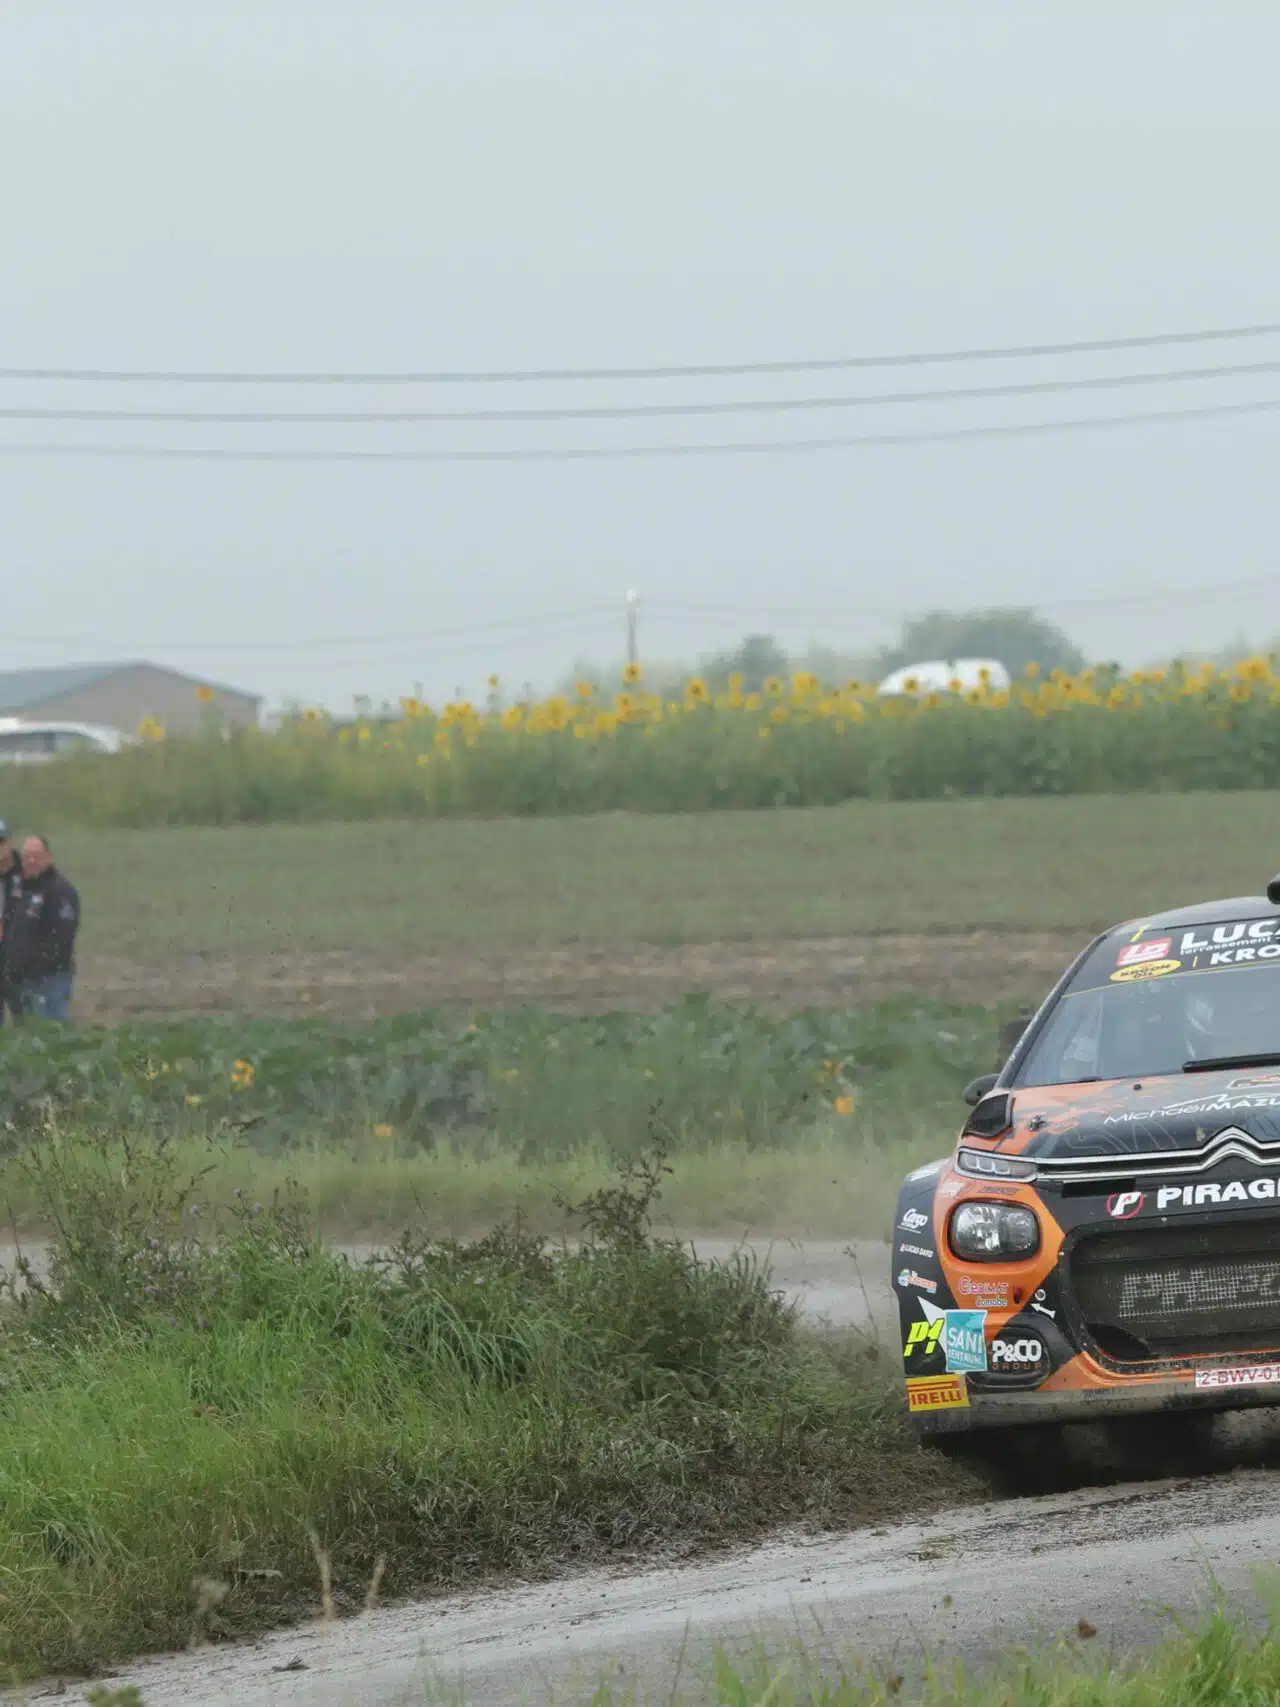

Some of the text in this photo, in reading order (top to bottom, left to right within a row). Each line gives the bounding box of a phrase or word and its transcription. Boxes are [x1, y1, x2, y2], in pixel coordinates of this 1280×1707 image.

[1180, 936, 1272, 956] terrassement
[903, 1208, 929, 1229] Cargo
[903, 1318, 945, 1357] P1
[947, 1327, 983, 1354] SANI
[991, 1339, 1043, 1363] P&CO
[991, 1362, 1042, 1371] GROUP
